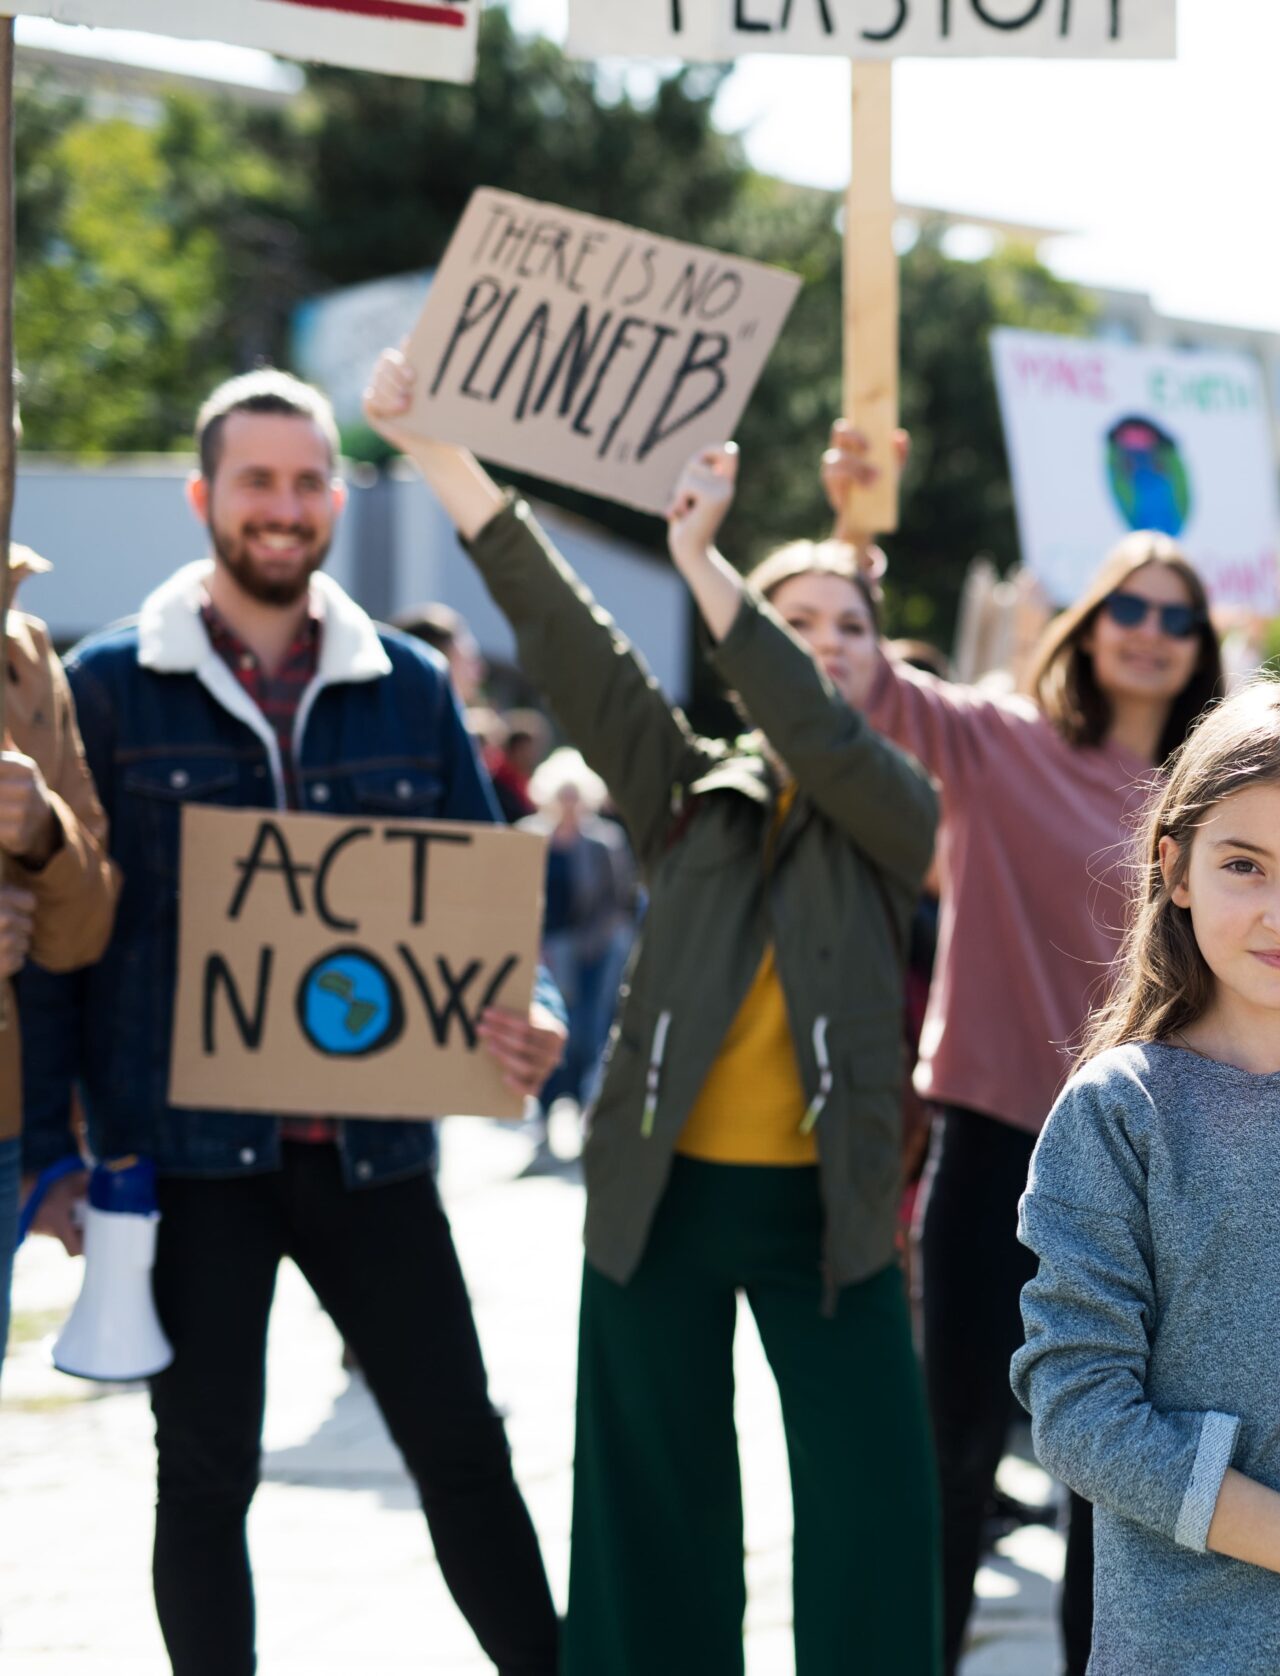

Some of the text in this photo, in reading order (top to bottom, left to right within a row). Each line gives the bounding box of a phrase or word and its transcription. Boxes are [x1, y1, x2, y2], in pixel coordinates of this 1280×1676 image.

[471, 204, 744, 322] THERE IS NO
[430, 274, 678, 463] PLANET
[226, 818, 474, 934] ACT
[201, 941, 520, 1060] NOW
